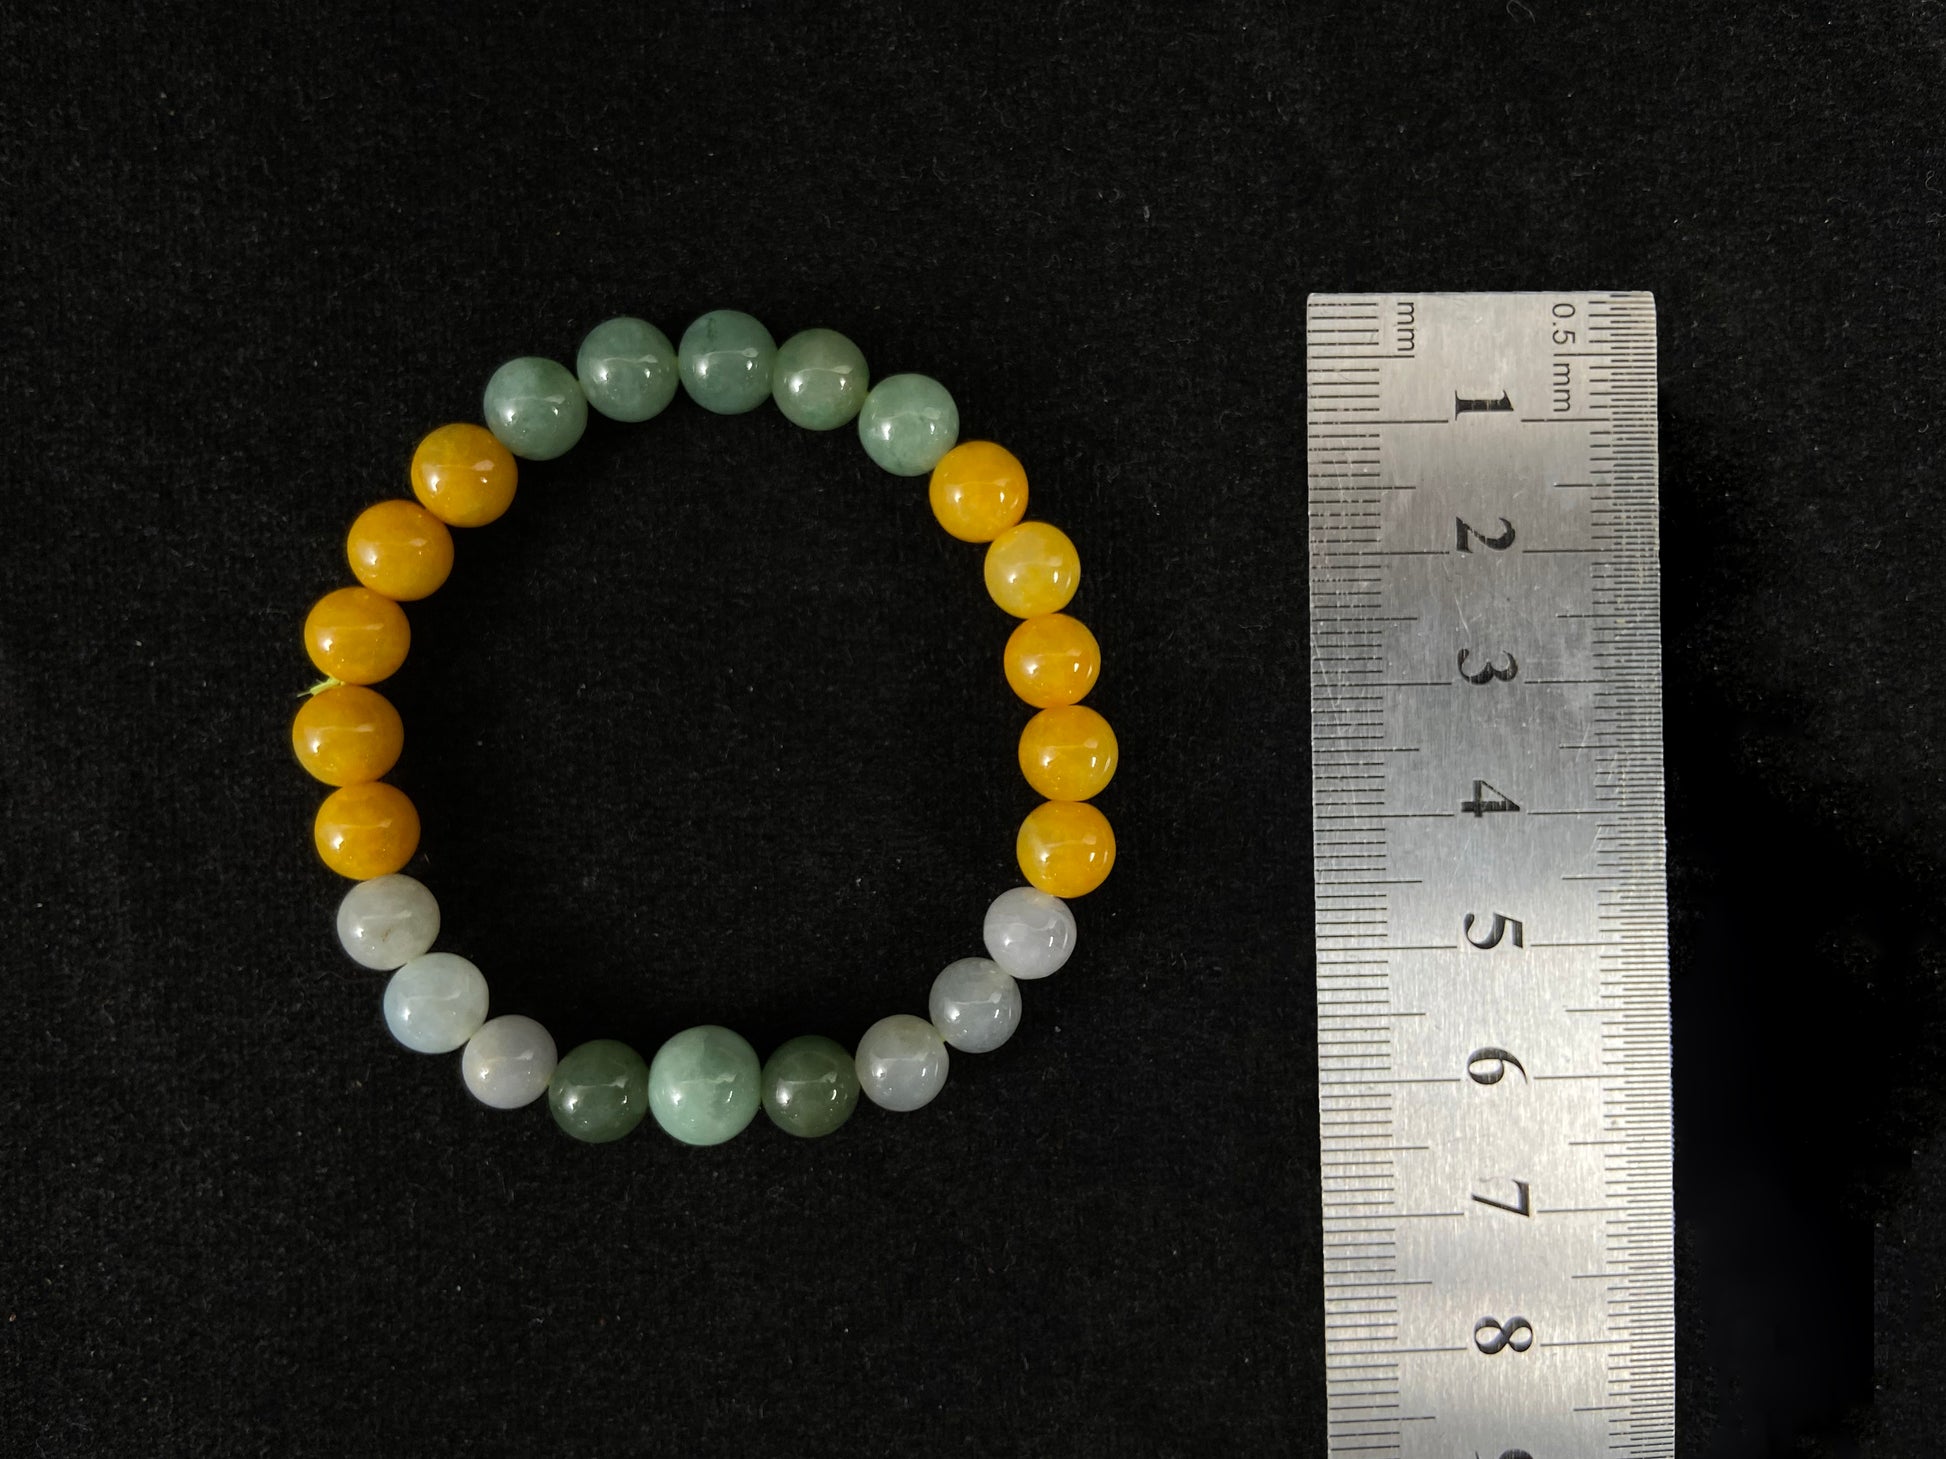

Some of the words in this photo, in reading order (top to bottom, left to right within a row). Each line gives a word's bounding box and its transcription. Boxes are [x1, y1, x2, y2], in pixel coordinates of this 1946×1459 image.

[1397, 302, 1415, 351] mm
[1552, 303, 1576, 345] 0.5
[1455, 389, 1514, 421] 1
[1553, 363, 1571, 412] mm
[1456, 516, 1515, 554] 2
[1458, 648, 1518, 685] 3
[1460, 779, 1520, 818] 4
[1463, 912, 1523, 949] 5
[1467, 1047, 1528, 1085] 6
[1471, 1178, 1530, 1218] 7
[1474, 1316, 1533, 1355] 8
